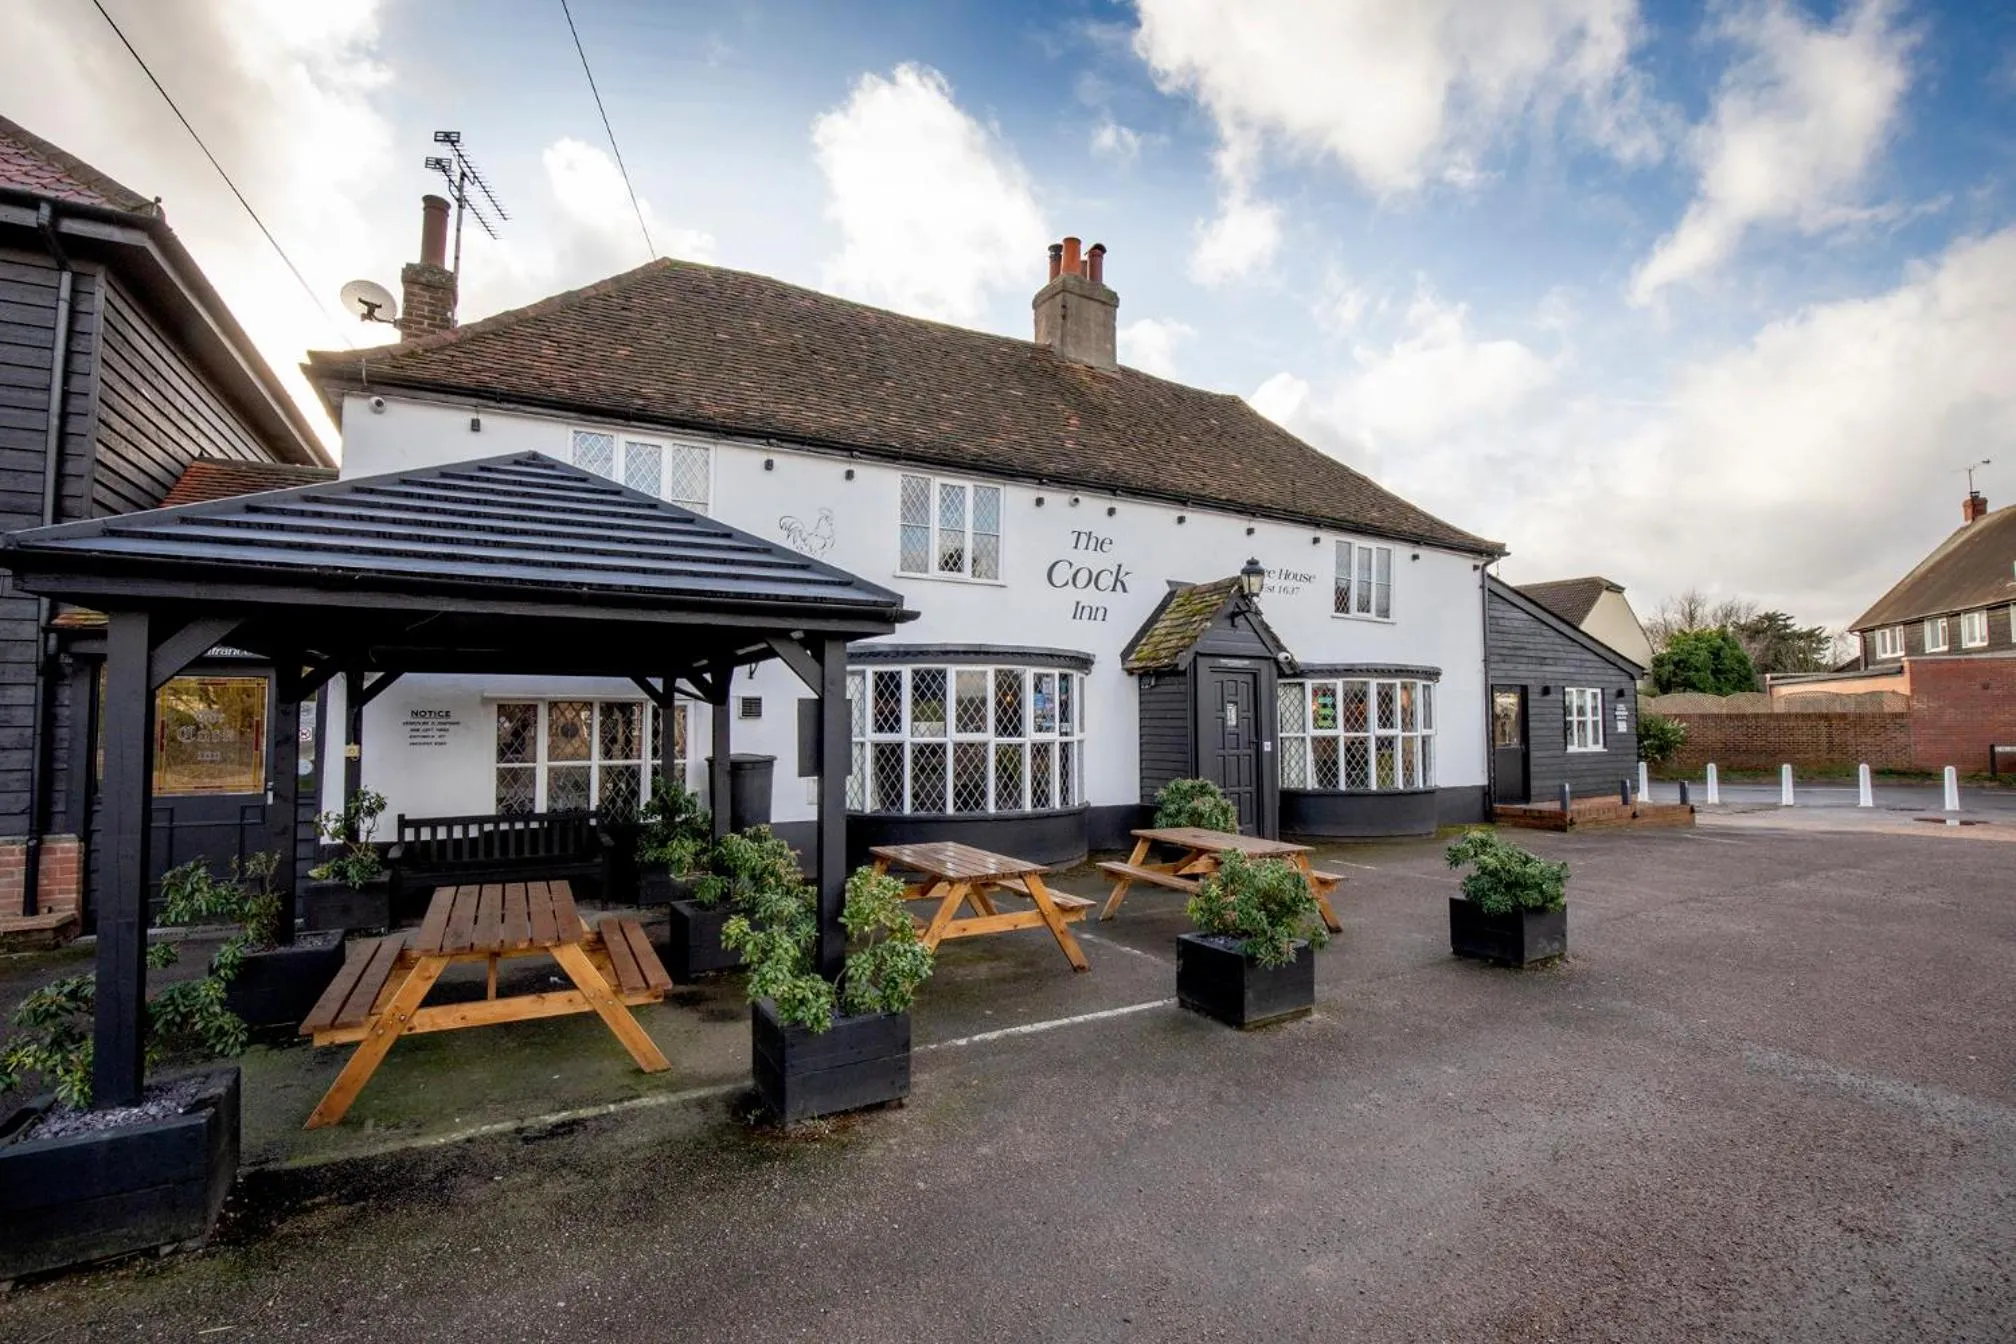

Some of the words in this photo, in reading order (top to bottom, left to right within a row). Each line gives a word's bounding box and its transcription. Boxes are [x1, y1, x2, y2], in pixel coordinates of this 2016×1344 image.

[1071, 530, 1113, 553] The
[1046, 559, 1133, 593] Cock
[1278, 568, 1316, 583] House
[1072, 600, 1109, 621] Inn
[410, 709, 451, 718] NOTICE
